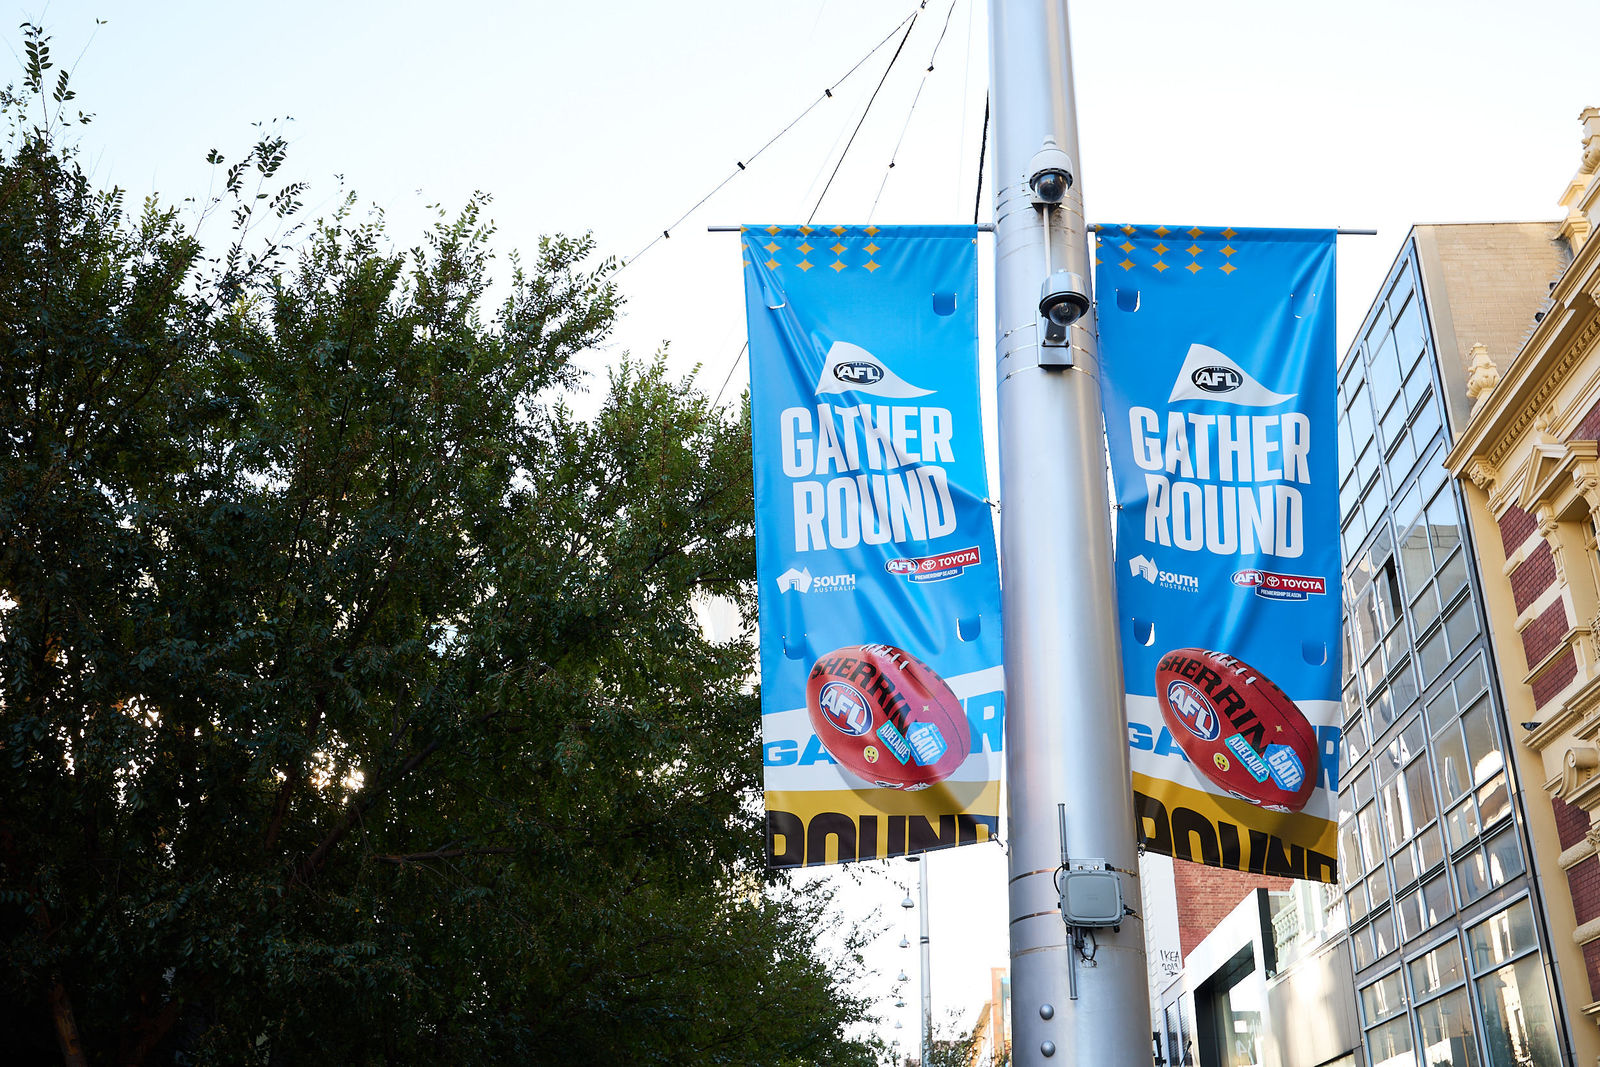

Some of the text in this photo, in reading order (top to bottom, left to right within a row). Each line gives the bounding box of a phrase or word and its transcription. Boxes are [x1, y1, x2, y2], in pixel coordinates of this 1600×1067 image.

[837, 365, 880, 383] AFL
[1195, 372, 1241, 389] AFL
[781, 403, 955, 478] GATHER
[1129, 406, 1311, 484] GATHER
[793, 465, 957, 552] ROUND
[1144, 473, 1304, 558] ROUND
[887, 560, 917, 571] AFL
[938, 552, 977, 567] TOYOTA
[813, 574, 856, 588] SOUTH
[1159, 570, 1198, 588] SOUTH
[1234, 572, 1263, 584] AFL
[1282, 578, 1322, 590] TOYOTA
[814, 585, 856, 593] AUSTRALIA
[1160, 582, 1199, 593] AUSTRALIA
[820, 686, 864, 735] AFL
[1168, 685, 1212, 740] AFL
[879, 723, 910, 758] ADELAIDE
[910, 727, 941, 763] GATH
[1228, 736, 1268, 776] ADELAIDE
[1268, 750, 1302, 788] GATH
[1160, 949, 1180, 964] IKEA
